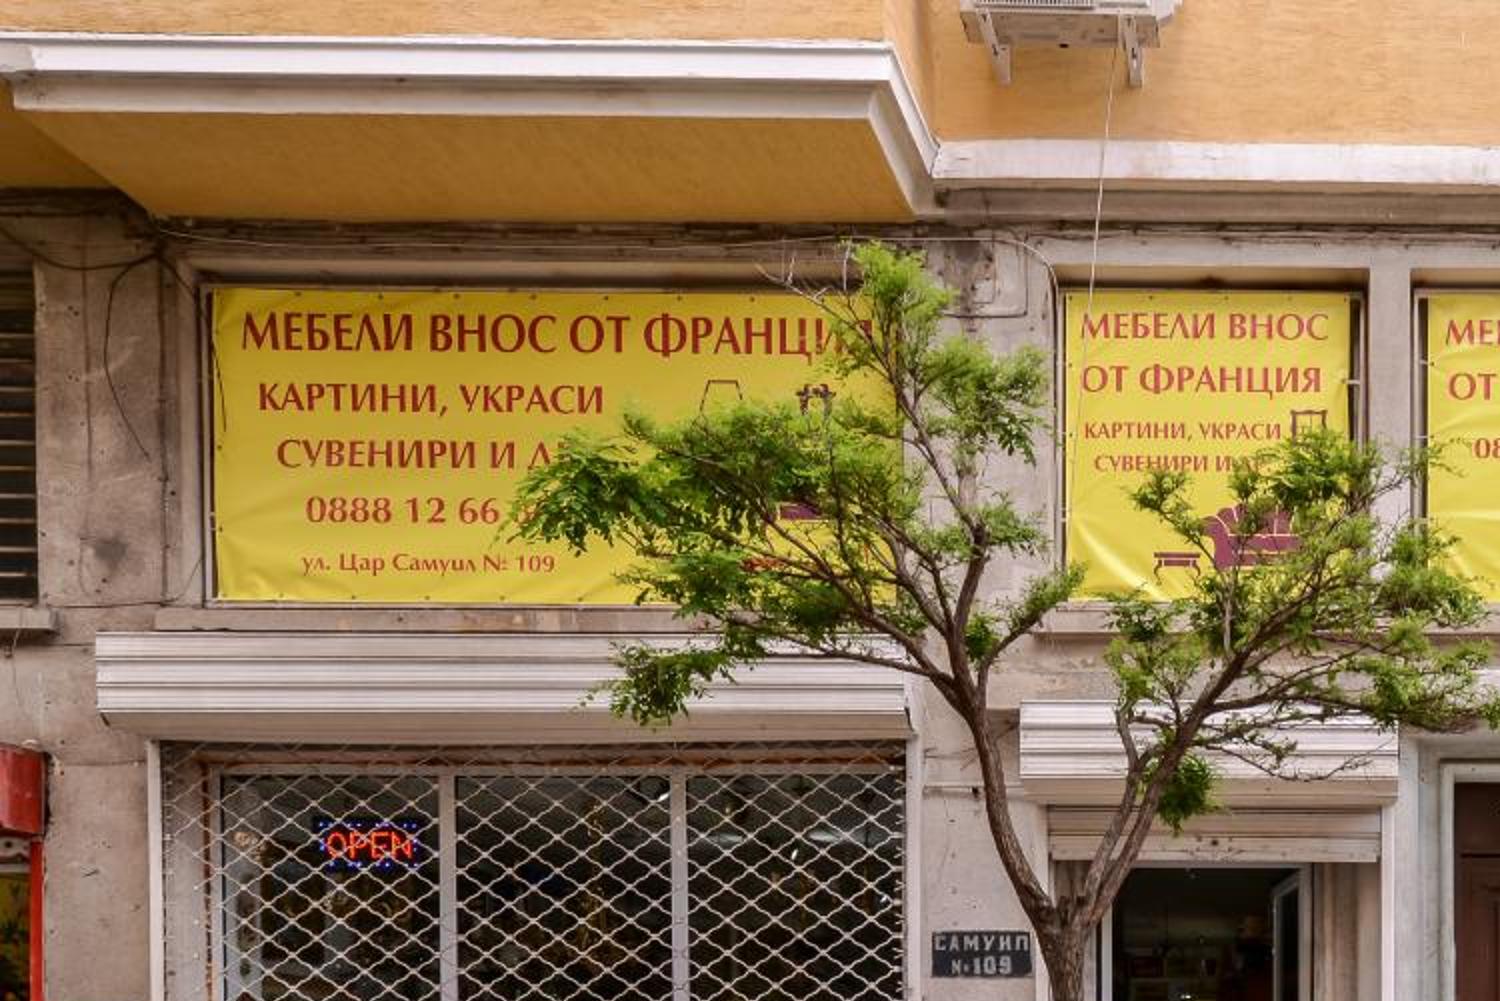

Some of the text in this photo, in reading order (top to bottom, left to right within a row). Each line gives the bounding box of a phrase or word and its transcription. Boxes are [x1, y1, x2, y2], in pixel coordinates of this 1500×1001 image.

[242, 312, 873, 366] МЕБЕЛИ ВНОС ОТ ФРАНЦИ
[1081, 312, 1329, 341] МЕБЕЛИ ВНОС
[1082, 363, 1322, 400] ОТ ФРАНЦИЯ
[1448, 372, 1497, 402] ОТ
[258, 383, 603, 418] КАРТИНИ, УКРАСИ
[1084, 421, 1281, 441] КАРТИНИ, УКРАСИ
[276, 439, 475, 469] СУВЕНИРИ
[490, 441, 515, 469] И
[1094, 454, 1209, 472] СУВЕНИРИ
[1215, 455, 1232, 472] И
[306, 496, 392, 524] 0888
[405, 496, 446, 524] 12
[458, 496, 500, 524] 66
[302, 555, 330, 577] ул.
[339, 553, 386, 577] Цар
[392, 553, 475, 577] Самуил
[517, 554, 556, 573] 109
[326, 831, 413, 859] OPEN
